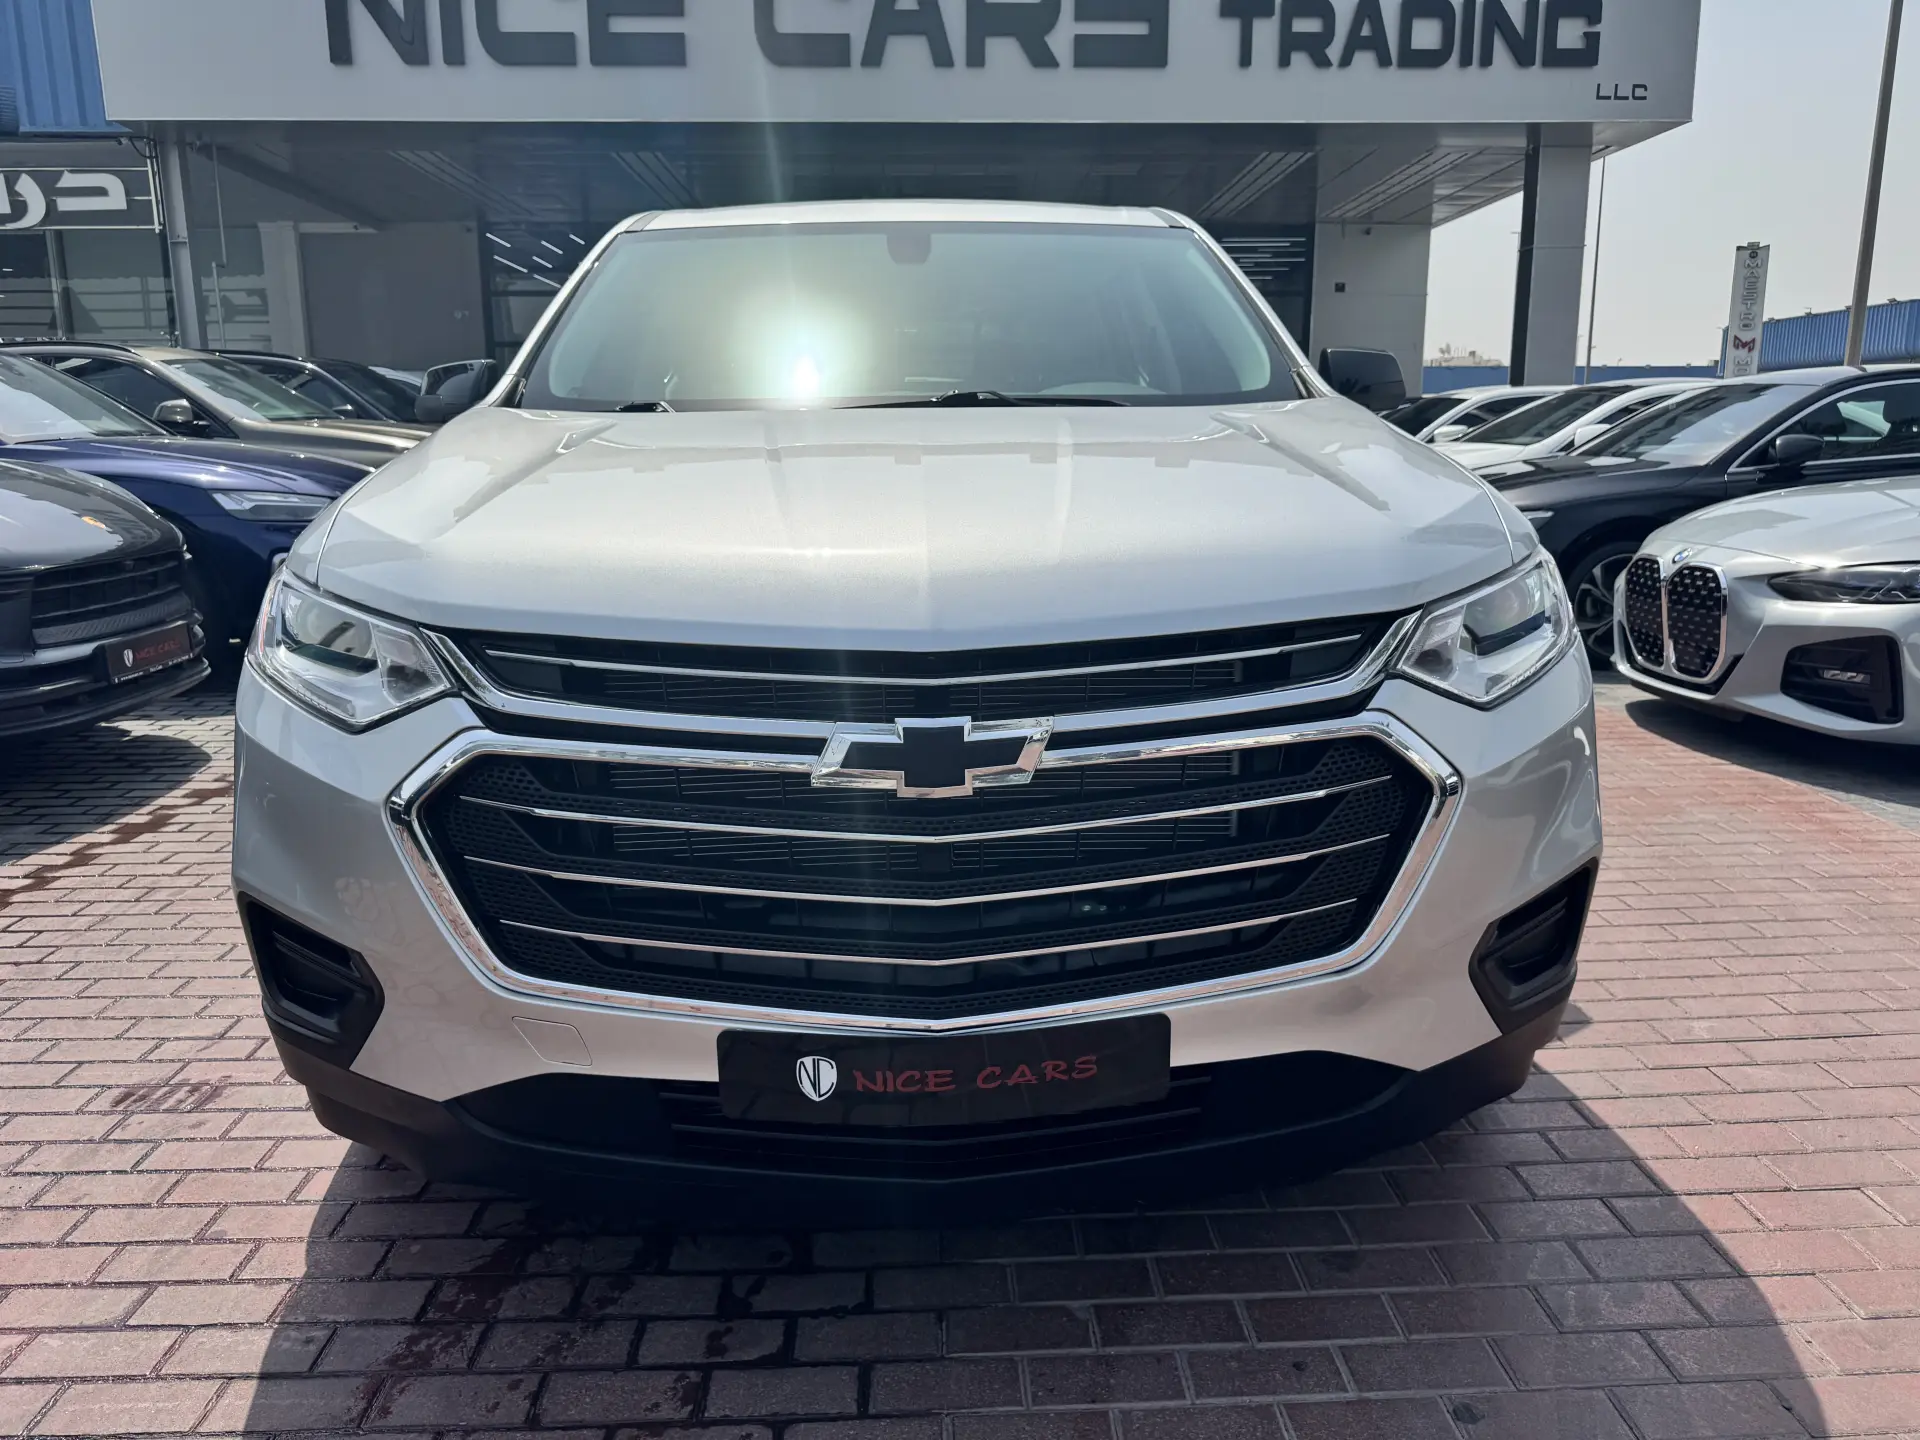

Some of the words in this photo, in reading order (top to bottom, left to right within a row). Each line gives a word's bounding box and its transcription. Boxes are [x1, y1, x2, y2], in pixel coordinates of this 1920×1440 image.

[326, 0, 687, 66] NICE
[753, 0, 1169, 68] CARS
[1219, 0, 1602, 67] TRADING
[1596, 83, 1648, 101] LLC
[1740, 258, 1763, 332] MAESTRO
[853, 1069, 957, 1093] NICE
[976, 1053, 1099, 1090] CARS
